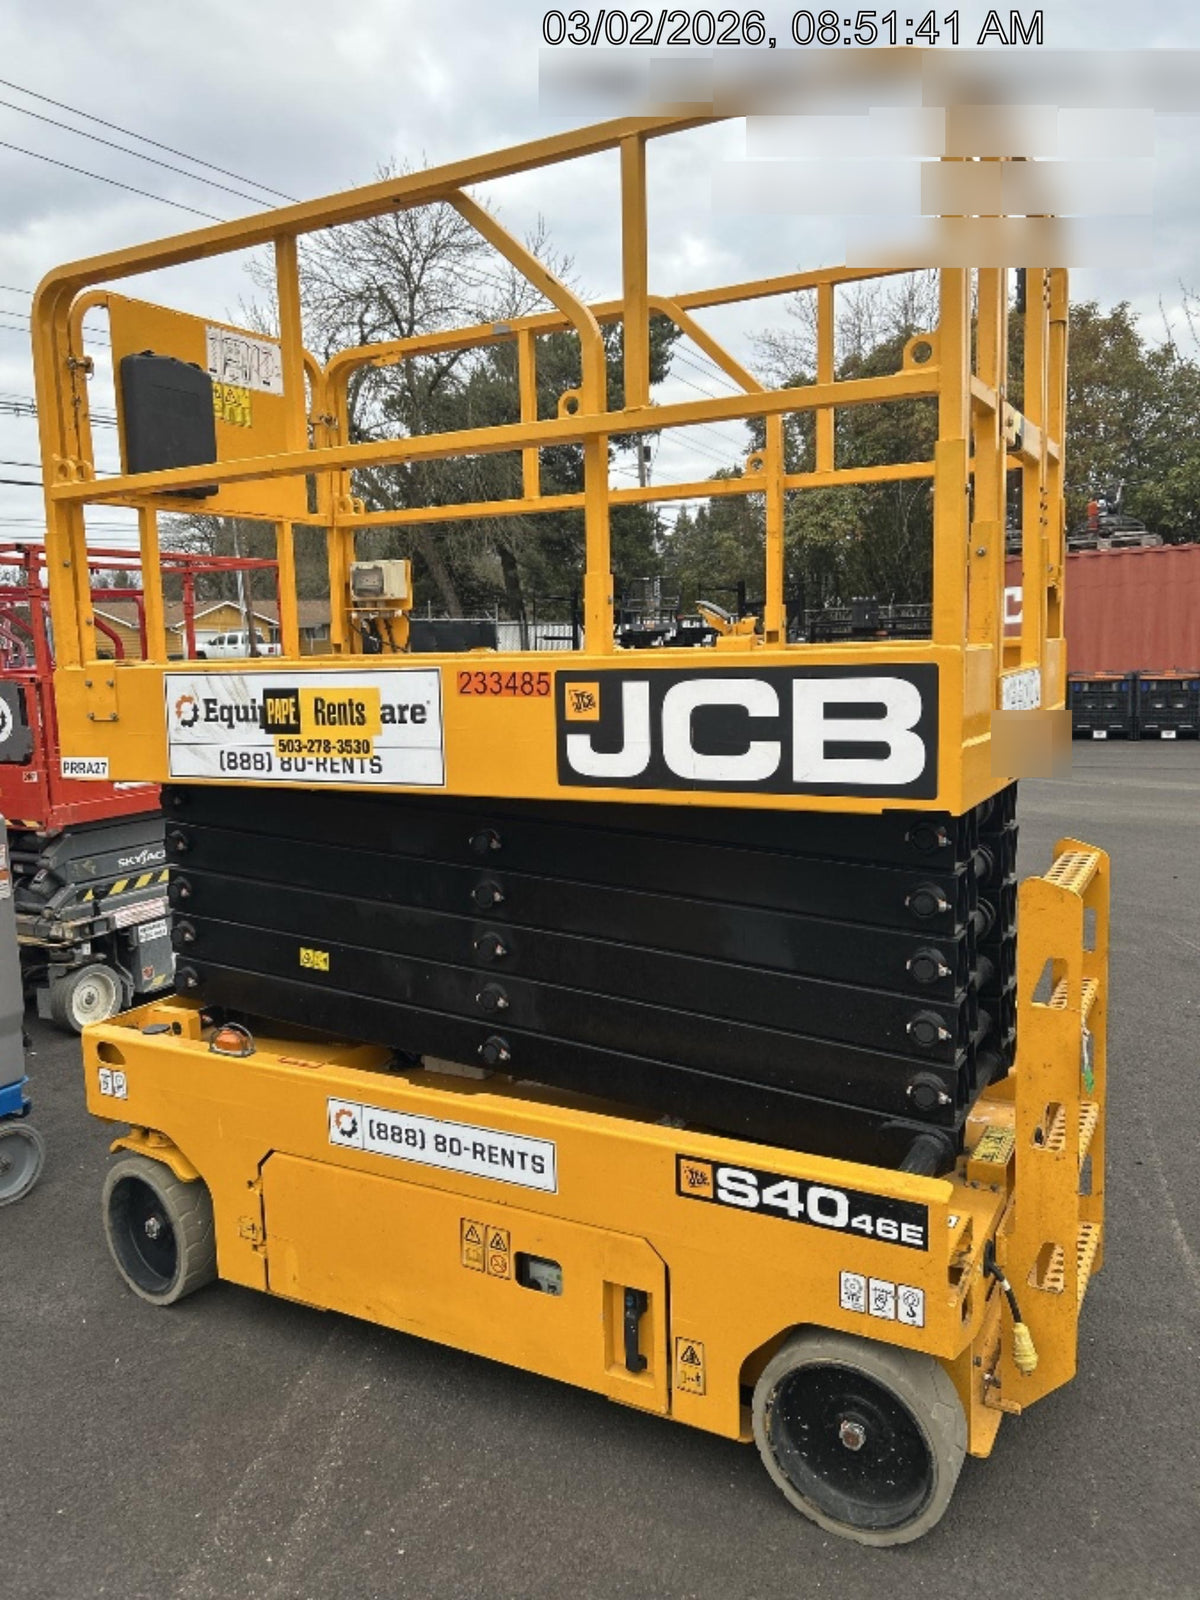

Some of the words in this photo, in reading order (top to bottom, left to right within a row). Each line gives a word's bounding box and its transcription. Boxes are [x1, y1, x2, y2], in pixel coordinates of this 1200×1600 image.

[459, 671, 551, 695] 233485
[314, 698, 366, 726] Rents
[566, 677, 926, 785] JCB
[278, 739, 370, 754] 503-278-3530
[63, 761, 107, 775] PRRA27
[219, 750, 273, 773] (888)
[368, 1119, 426, 1150] (888)
[434, 1133, 545, 1174] 80-RENTS
